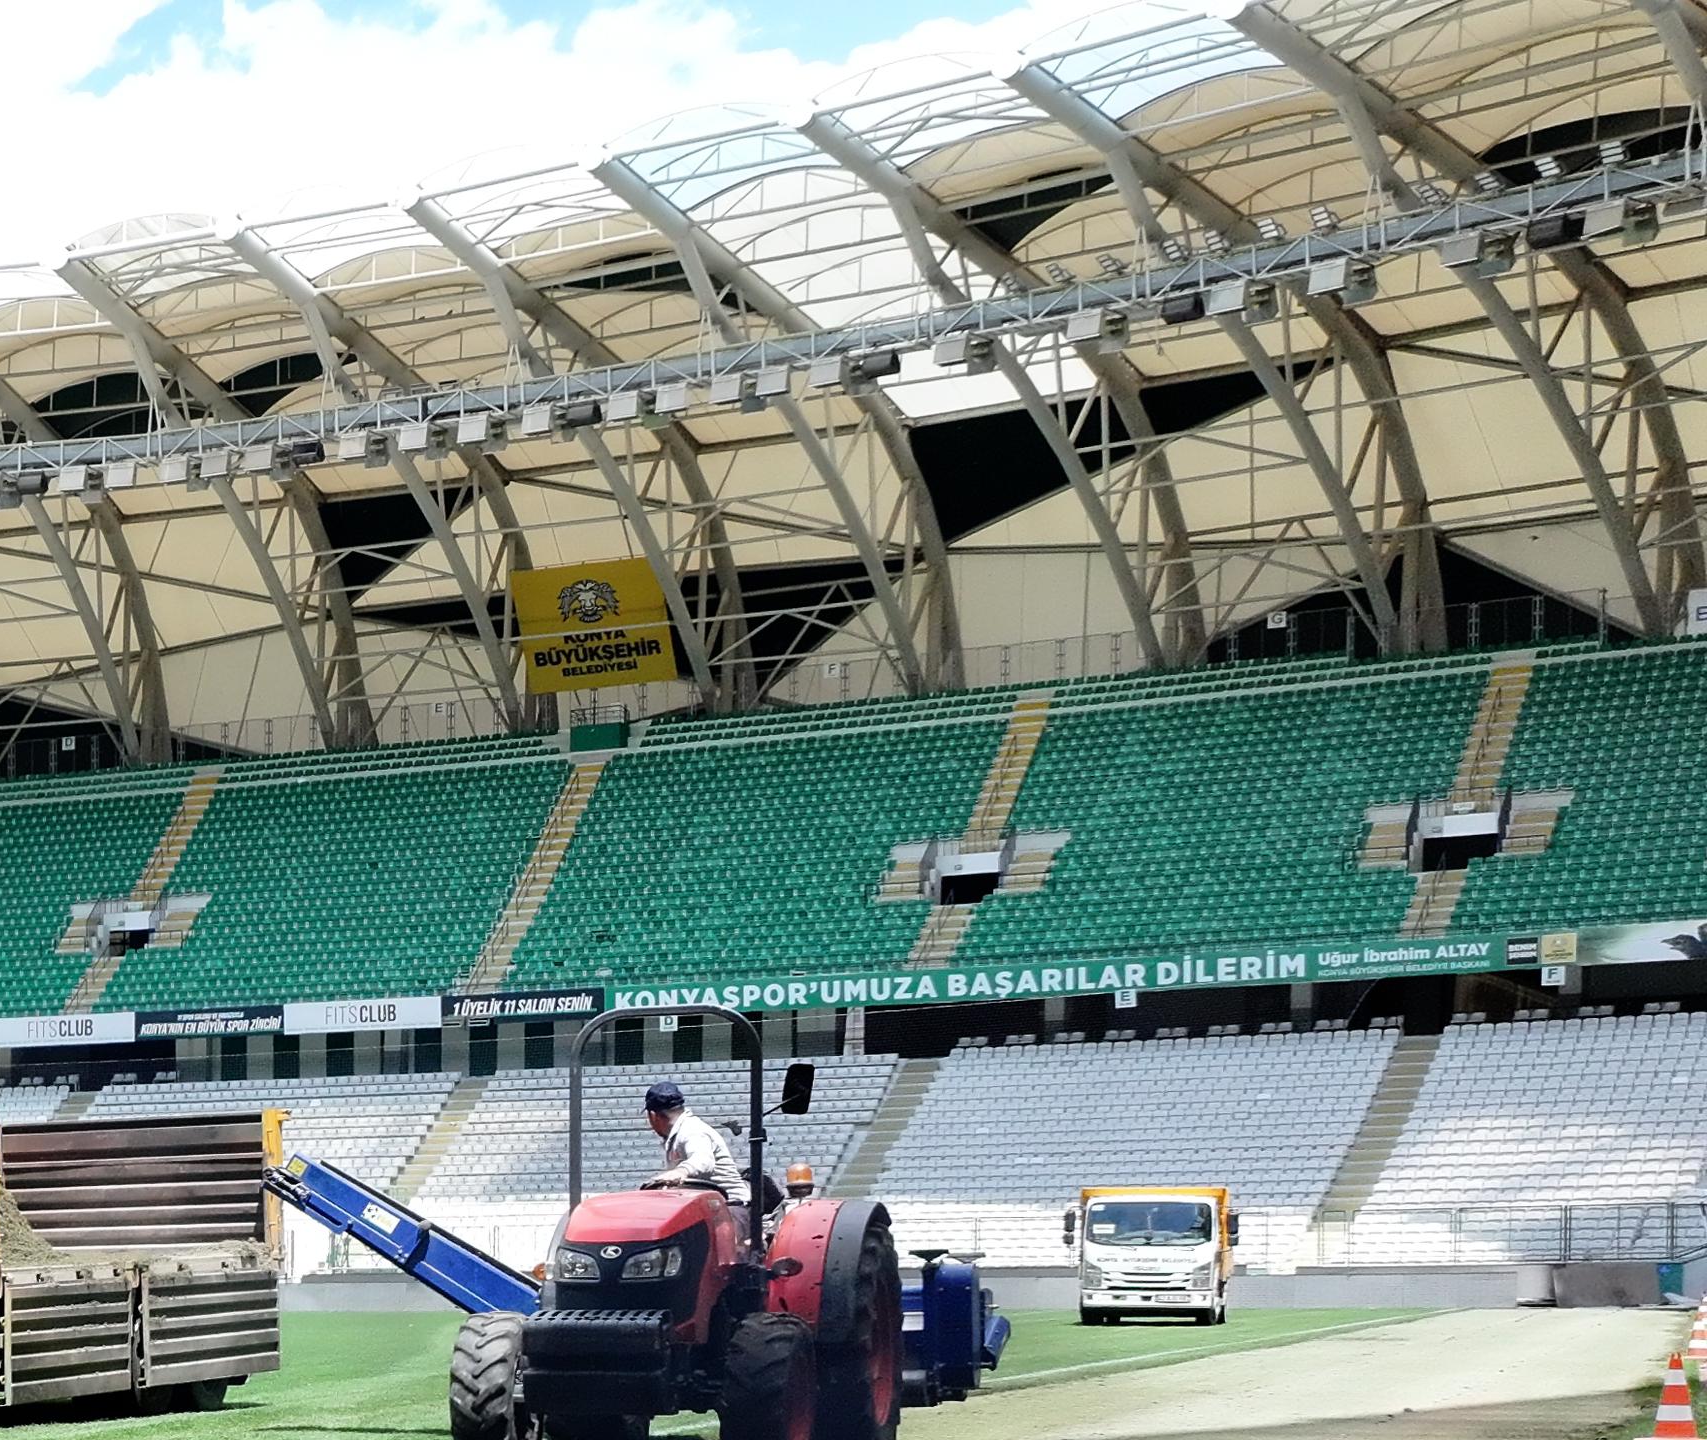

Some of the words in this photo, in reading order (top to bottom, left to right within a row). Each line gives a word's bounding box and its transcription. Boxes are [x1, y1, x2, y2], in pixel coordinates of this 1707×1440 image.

[1272, 613, 1283, 624] G
[534, 637, 662, 668] BÜYÜKŞEHİR
[562, 660, 638, 677] BELEDİYESİ
[828, 663, 836, 674] F
[435, 703, 443, 713] E
[64, 738, 72, 746] D
[1318, 952, 1359, 967] Uğur
[1364, 947, 1430, 963] İbrahim
[1435, 942, 1491, 958] ALTAY
[948, 963, 1146, 999] BAŞARILAR
[1157, 950, 1306, 986] DİLERİM
[1548, 968, 1557, 979] F
[1121, 991, 1130, 1001] E
[453, 1003, 461, 1017] 1
[461, 999, 502, 1017] ÜYELİK
[504, 1000, 516, 1014] 11
[517, 997, 556, 1013] SALON
[557, 993, 593, 1012] SENİN
[197, 1018, 226, 1034] BÜYÜK
[227, 1019, 250, 1032] SPOR
[664, 1017, 674, 1026] D
